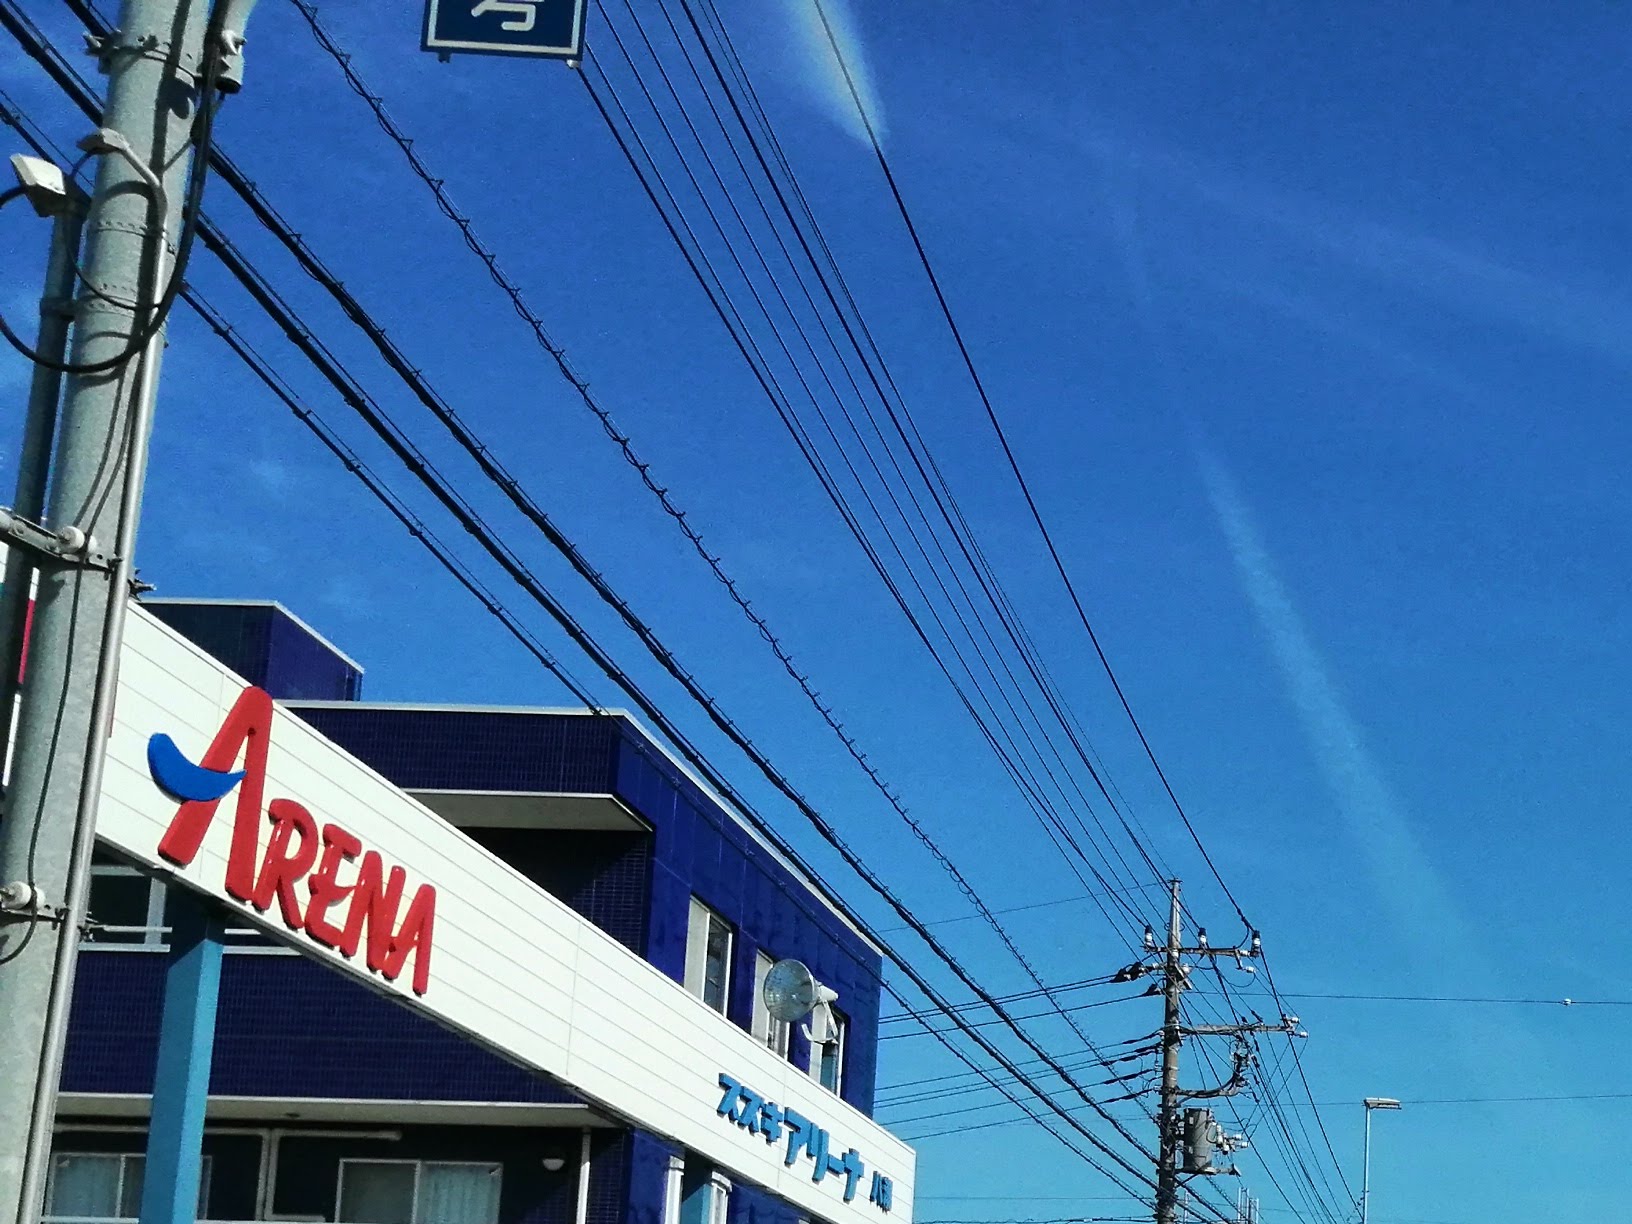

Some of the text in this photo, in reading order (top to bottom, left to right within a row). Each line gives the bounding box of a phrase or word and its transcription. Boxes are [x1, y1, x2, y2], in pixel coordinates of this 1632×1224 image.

[148, 686, 436, 996] ARENA
[716, 1073, 865, 1204] スズキアリーナ
